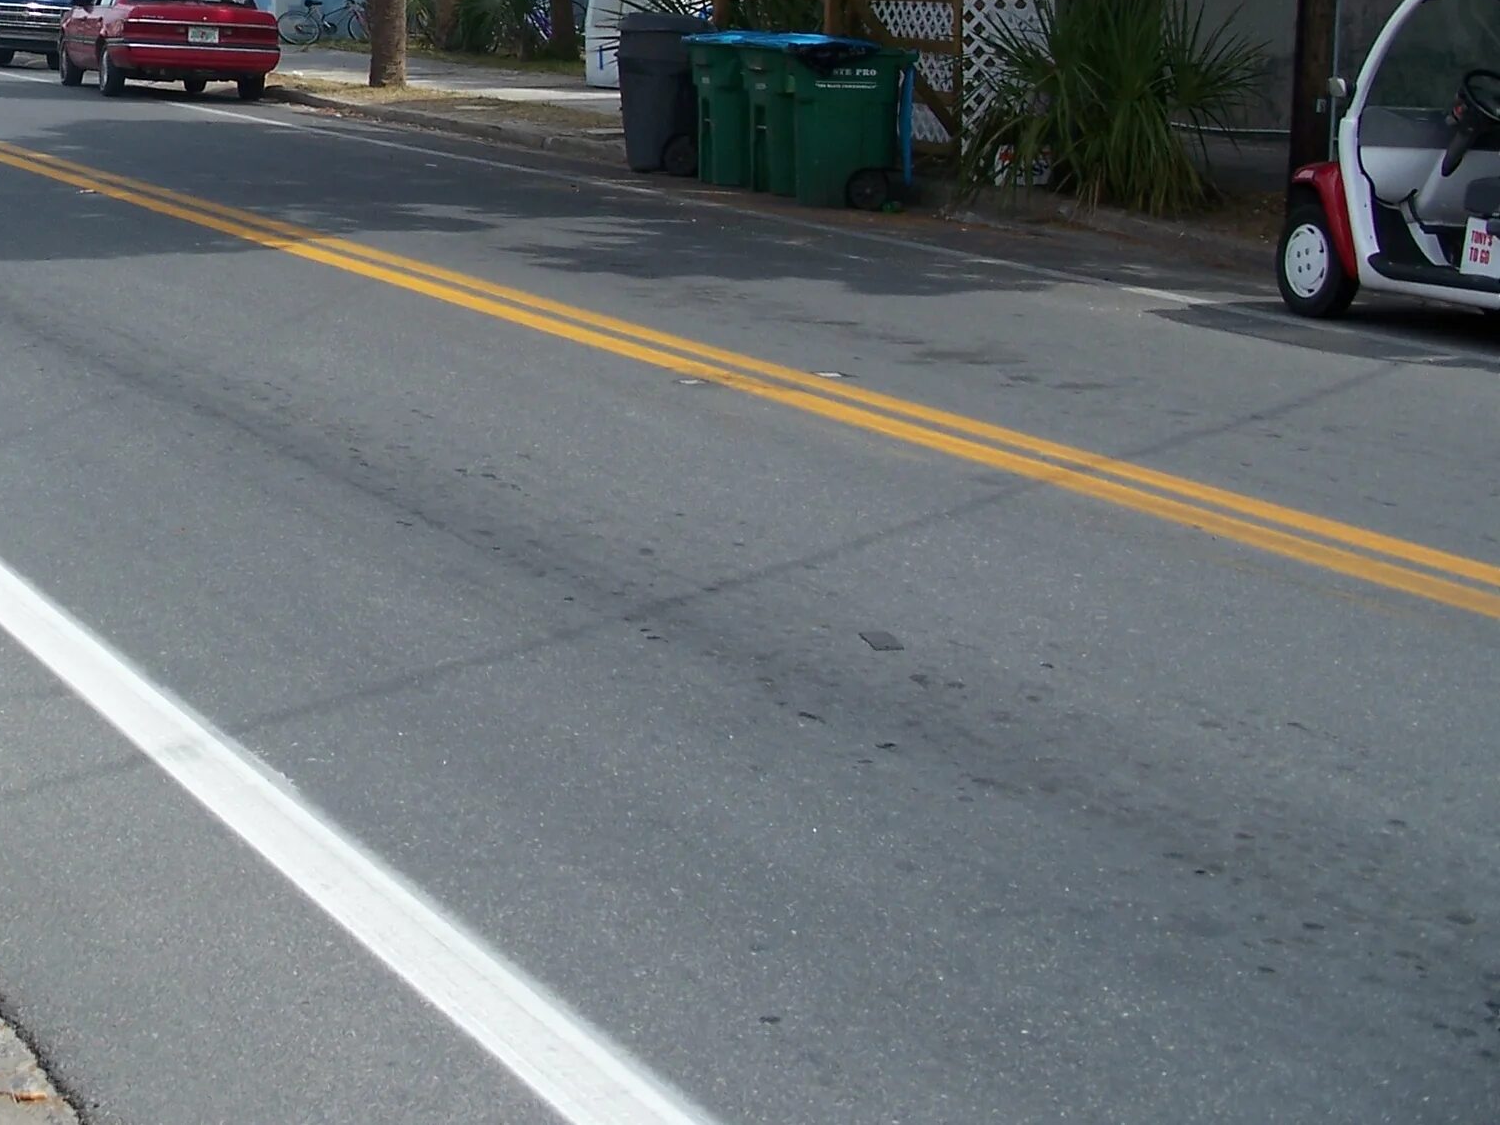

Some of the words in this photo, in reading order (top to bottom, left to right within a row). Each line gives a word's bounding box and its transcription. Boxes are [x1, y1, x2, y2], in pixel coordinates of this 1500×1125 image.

[855, 68, 877, 76] PRO
[1469, 246, 1479, 262] TO
[1479, 249, 1490, 264] GO
